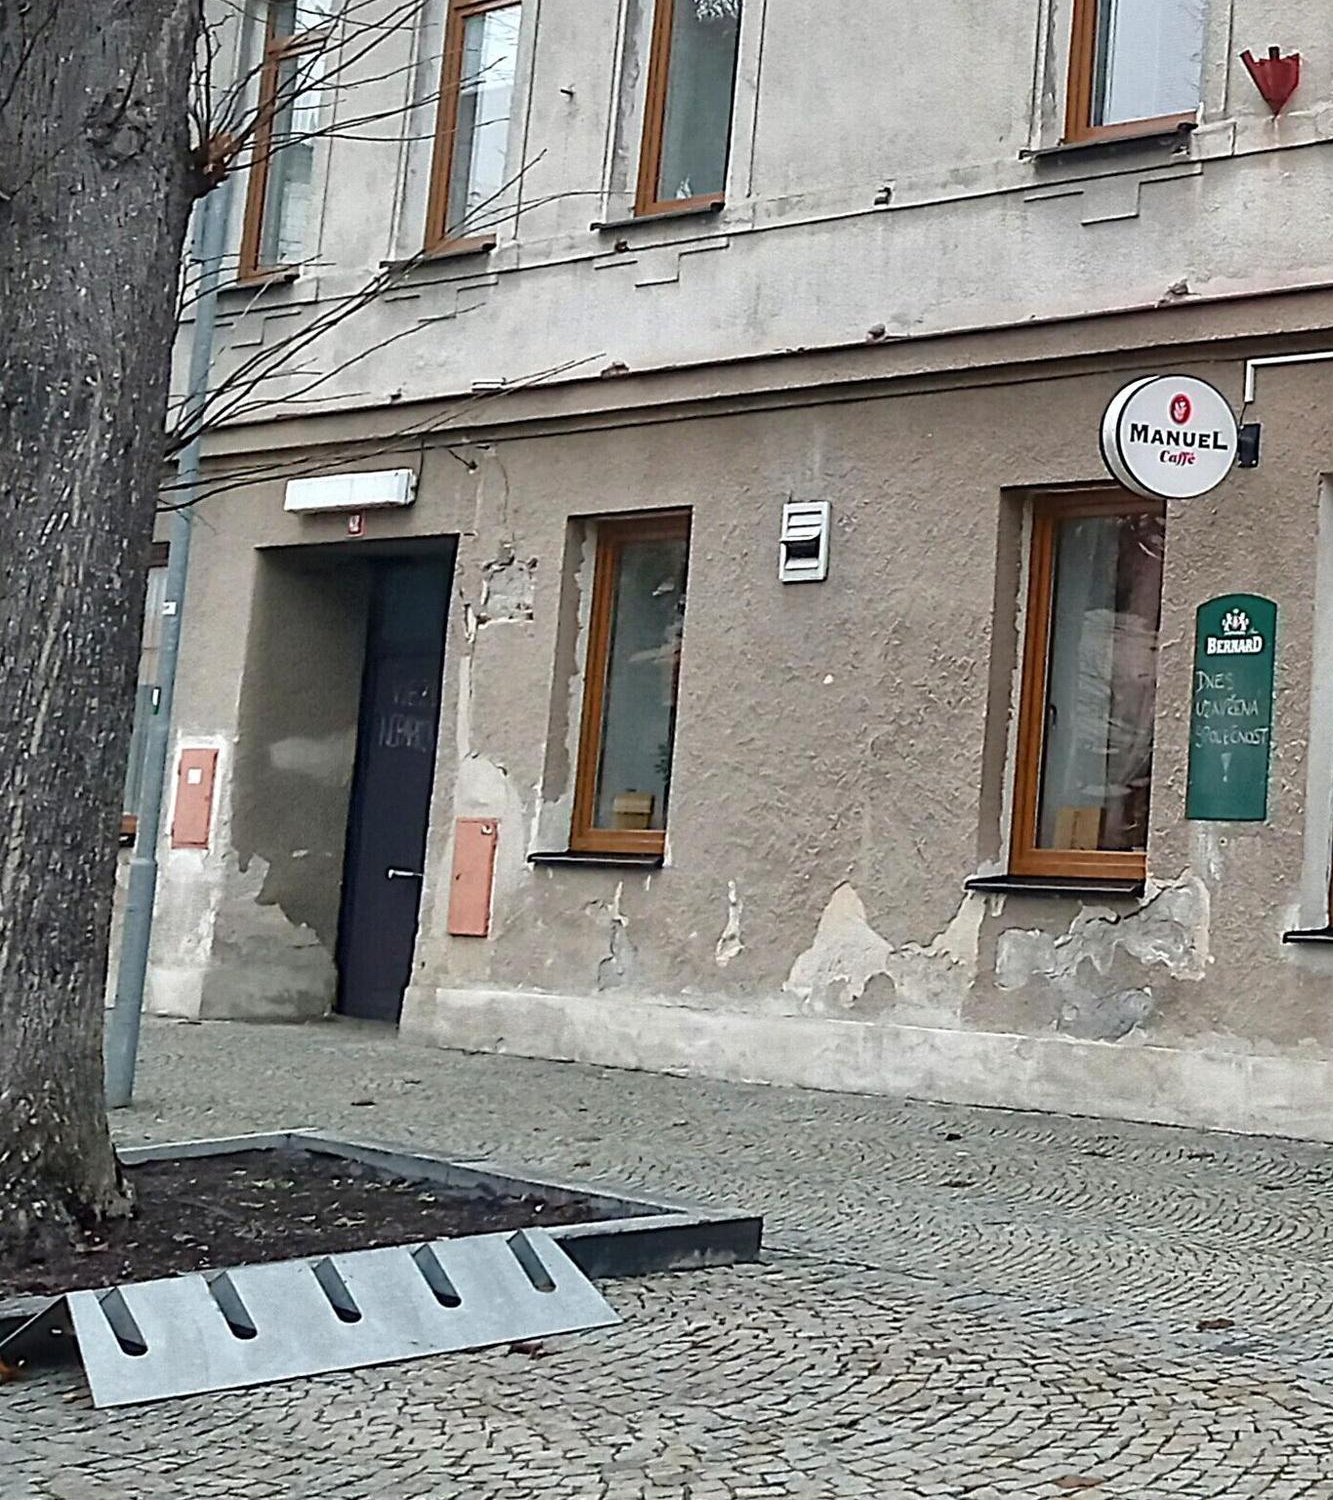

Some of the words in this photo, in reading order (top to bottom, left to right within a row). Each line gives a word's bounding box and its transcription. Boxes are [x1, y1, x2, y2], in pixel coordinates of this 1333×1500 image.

[1130, 423, 1228, 450] MANUEL
[1207, 636, 1263, 655] BERNARD
[1196, 670, 1234, 693] DNES
